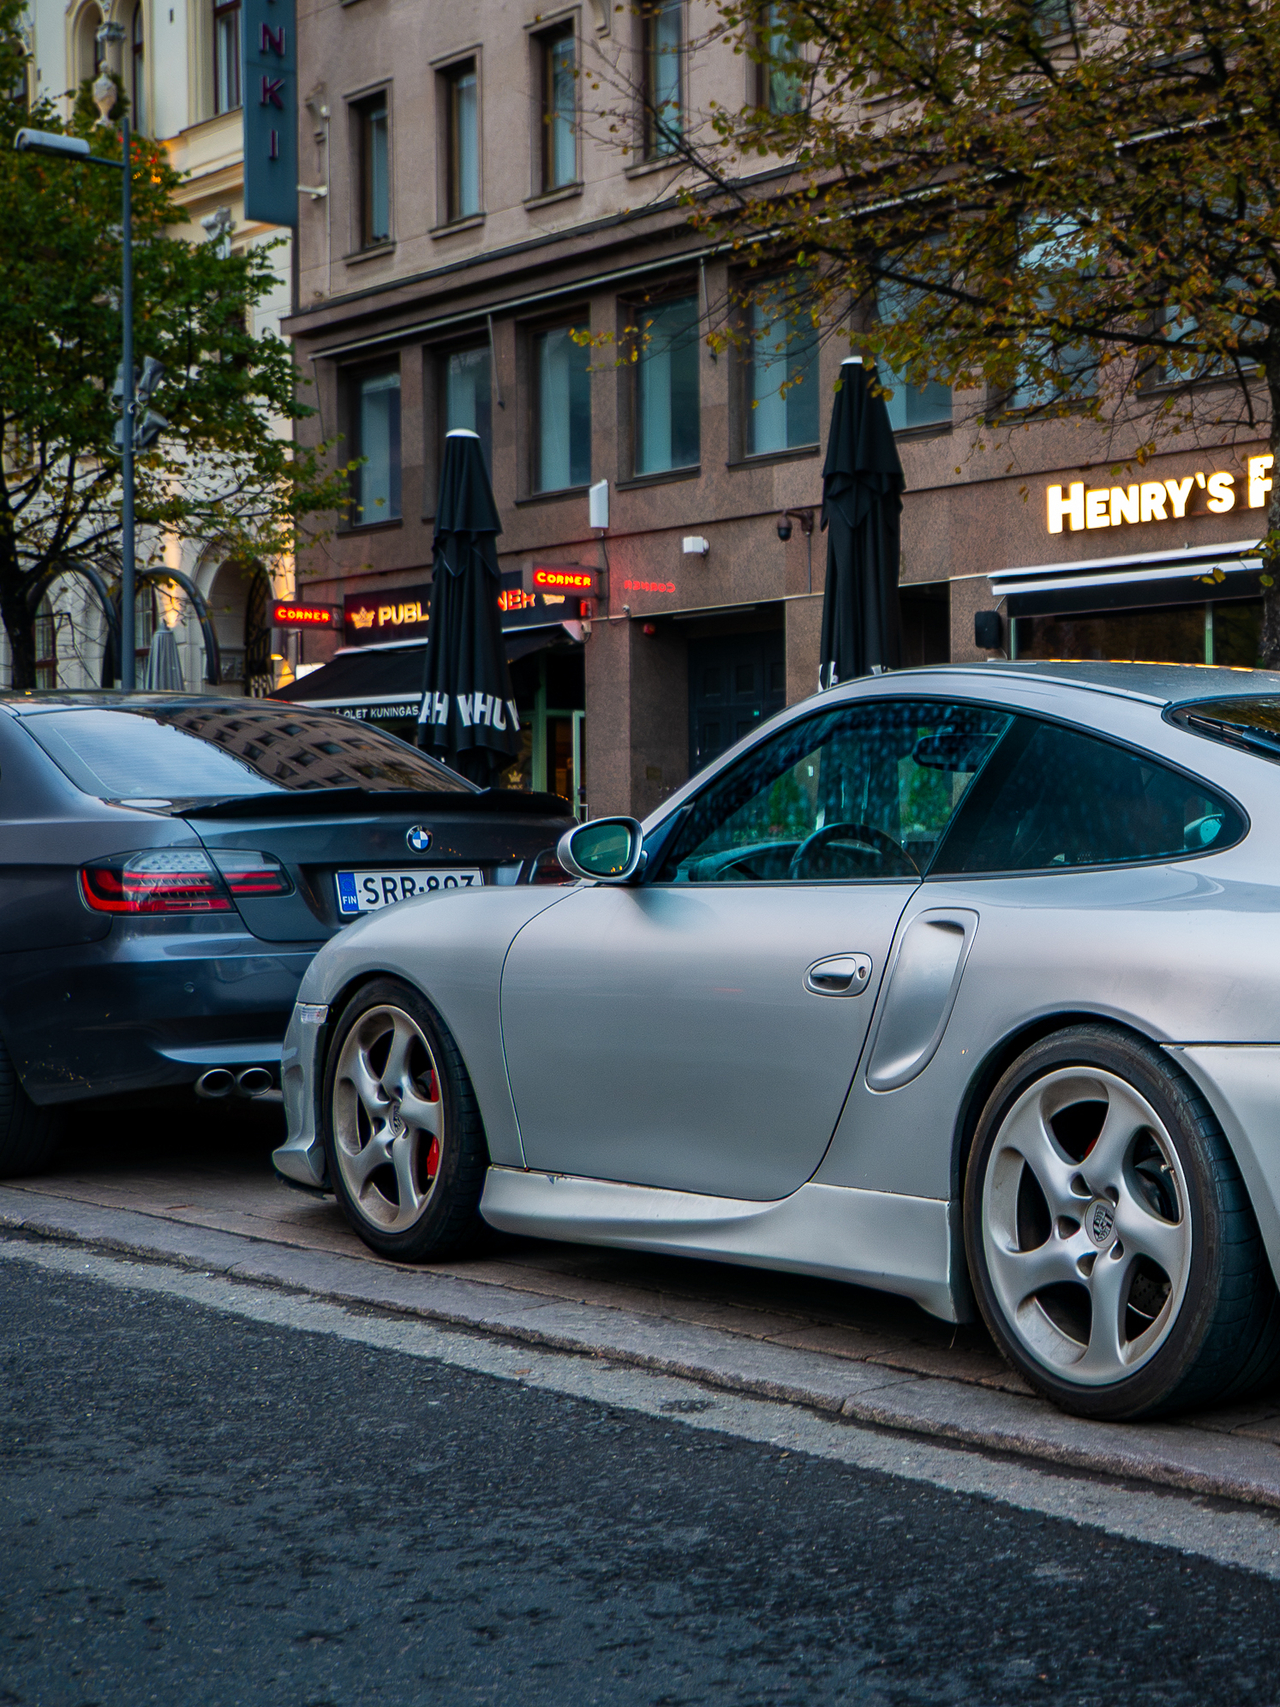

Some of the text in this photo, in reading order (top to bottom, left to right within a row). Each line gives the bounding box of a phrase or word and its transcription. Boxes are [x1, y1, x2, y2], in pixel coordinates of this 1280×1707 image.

[260, 0, 285, 159] NKI
[1047, 471, 1236, 534] HENRY'S
[534, 570, 592, 587] CORNER
[276, 607, 331, 623] CORNER
[378, 600, 431, 626] PUBL
[344, 708, 368, 723] OLET
[342, 895, 357, 905] FIN
